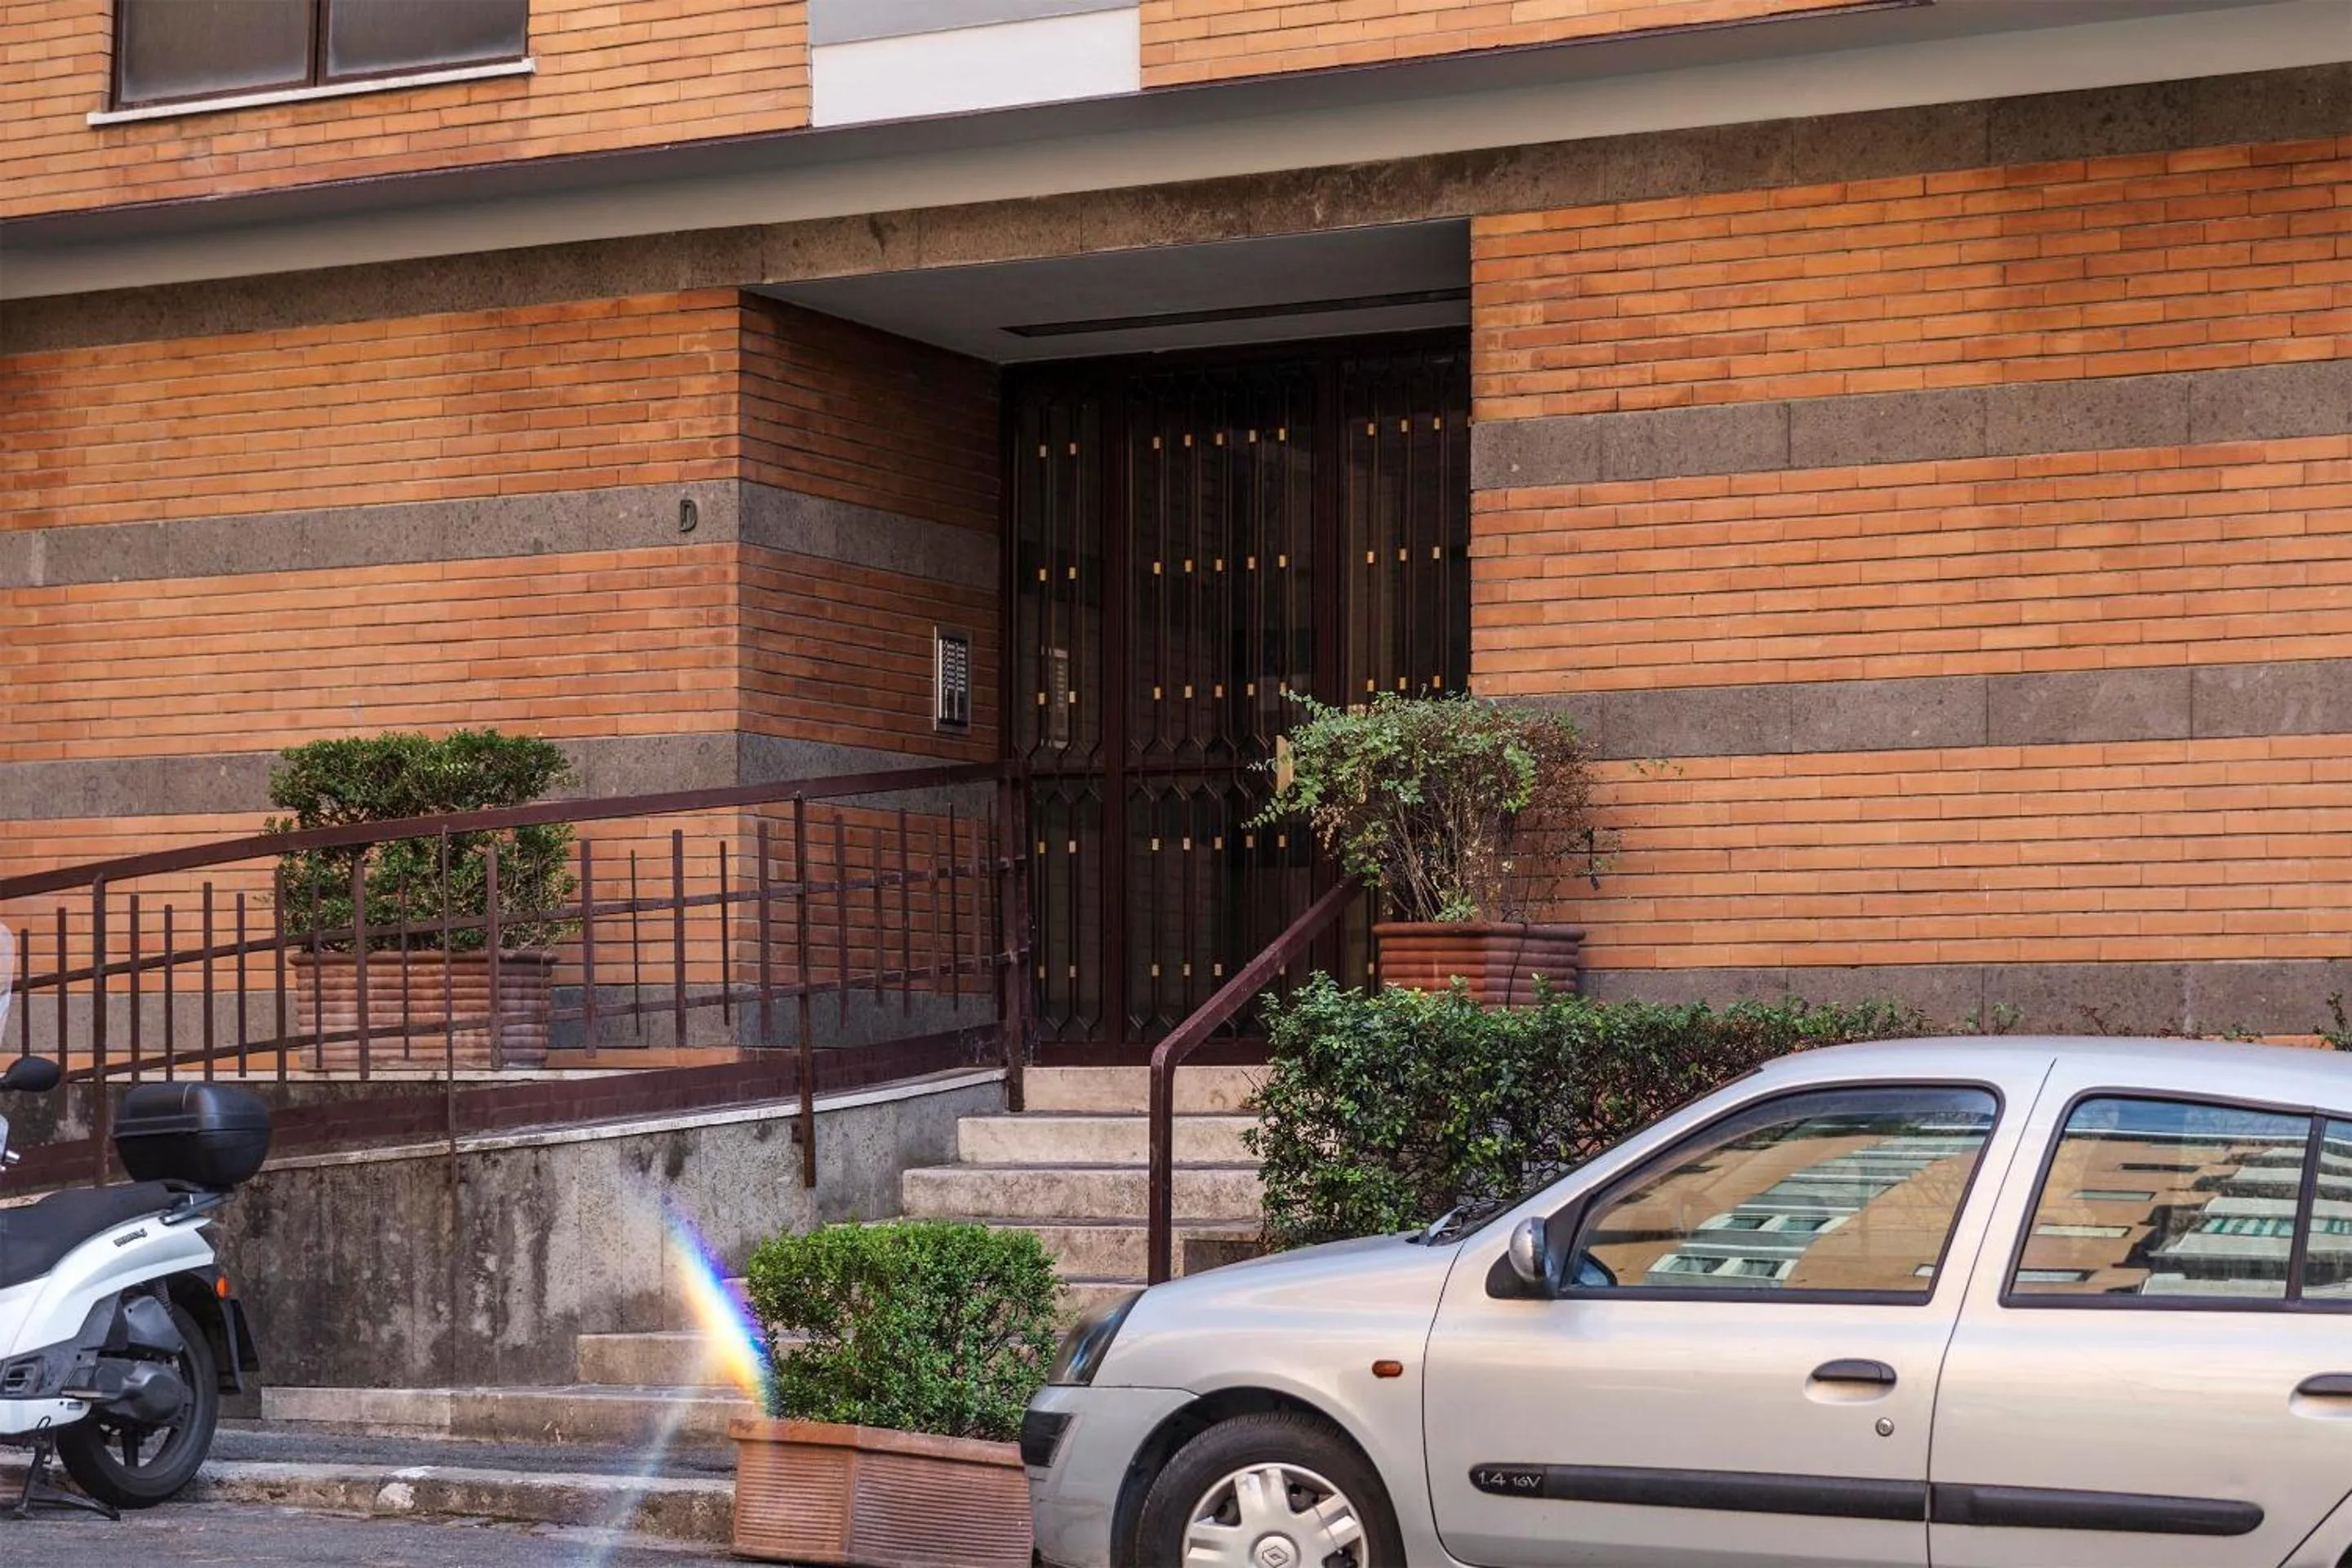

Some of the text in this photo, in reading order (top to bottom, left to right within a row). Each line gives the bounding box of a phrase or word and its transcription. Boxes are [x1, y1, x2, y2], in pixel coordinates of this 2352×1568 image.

[679, 499, 698, 532] D
[1478, 1471, 1541, 1487] 1.4 16V
